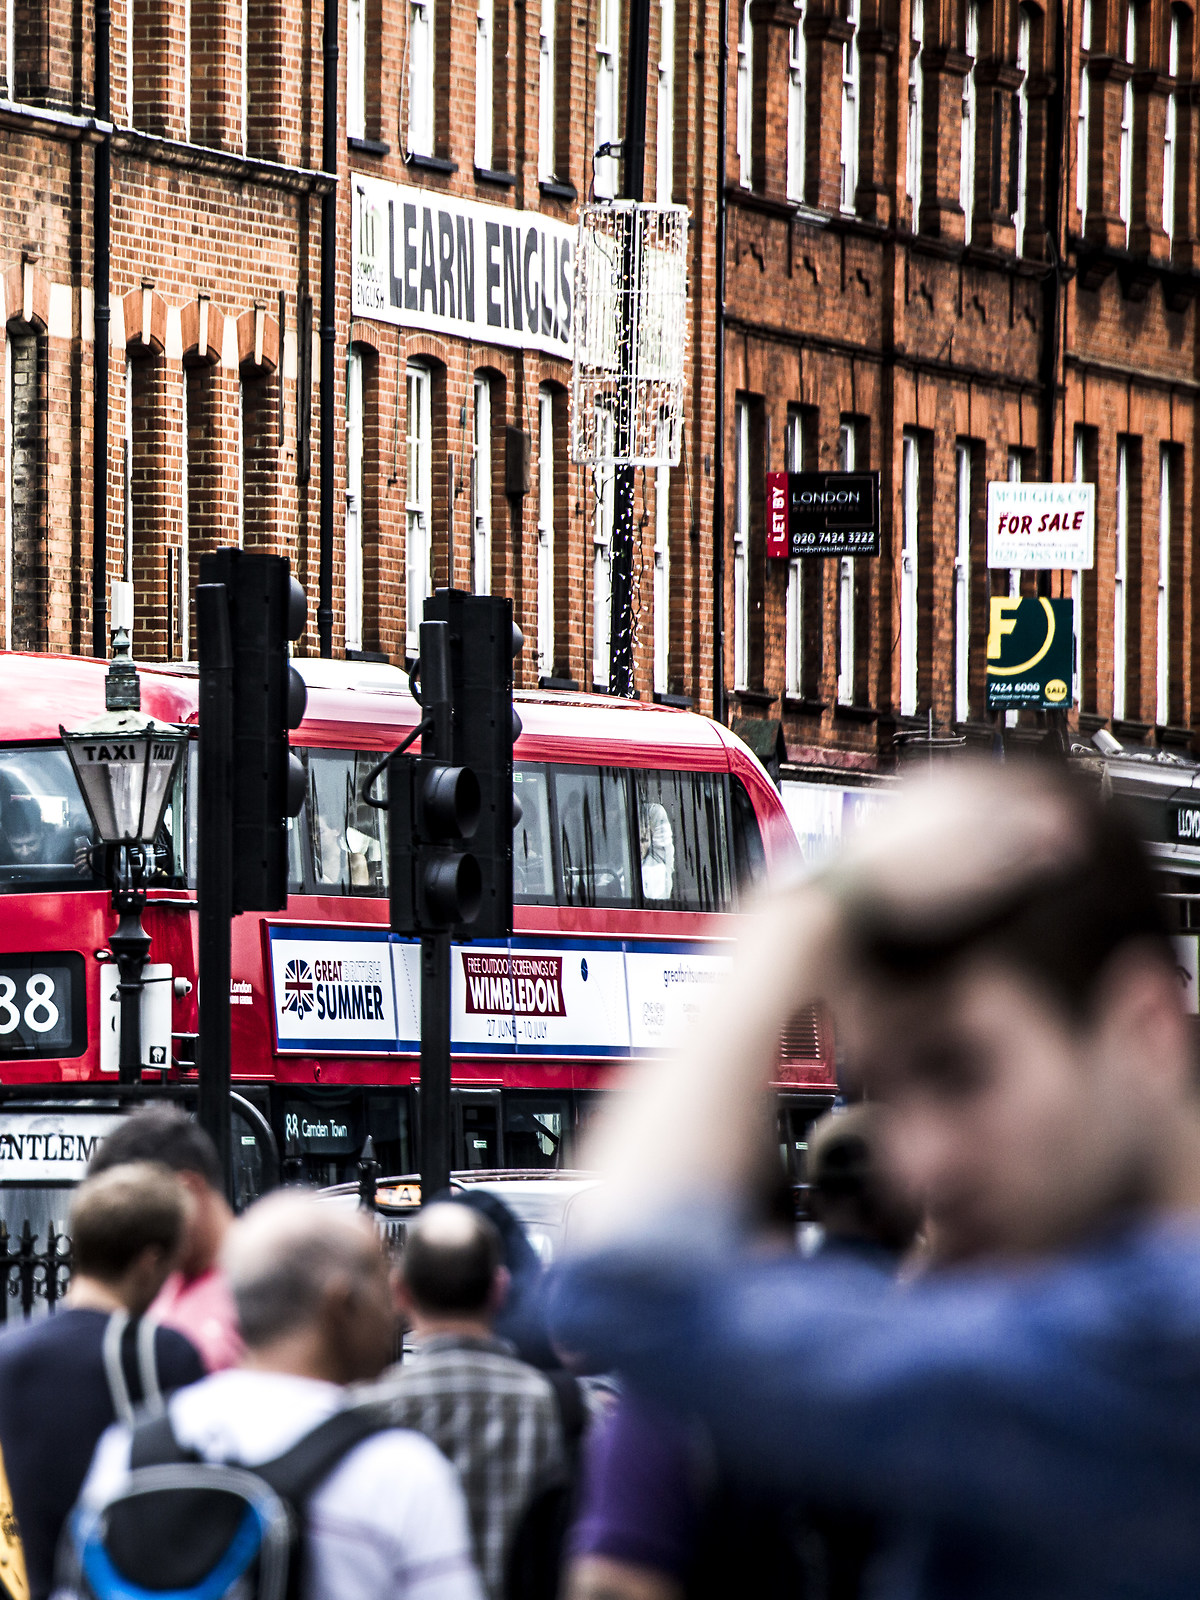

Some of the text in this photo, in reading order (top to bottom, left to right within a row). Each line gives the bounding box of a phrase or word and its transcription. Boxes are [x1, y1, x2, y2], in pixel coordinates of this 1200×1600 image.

[357, 261, 378, 283] SCHOOL
[388, 200, 575, 343] LEARN ENGLIS
[357, 283, 384, 310] ENGLISH
[792, 490, 860, 504] LONDON
[772, 486, 785, 542] LET BY
[997, 510, 1085, 534] FOR SALE
[793, 531, 875, 544] 020 7424 3222
[987, 596, 1023, 659] F
[989, 682, 1040, 693] 7424 6000
[83, 744, 136, 761] TAXI
[153, 744, 175, 760] TAXI
[314, 960, 383, 983] GREAT BRITISH
[467, 957, 481, 973] FREE
[511, 959, 549, 977] SCREENINGS
[549, 960, 558, 976] OF
[316, 984, 385, 1021] SUMMER
[468, 976, 560, 1013] WIMBLEDON
[487, 1019, 495, 1037] 27
[497, 1019, 517, 1038] JUNE
[524, 1020, 532, 1038] 10
[533, 1020, 548, 1039] JULY
[285, 1113, 348, 1141] 88 Camden Town
